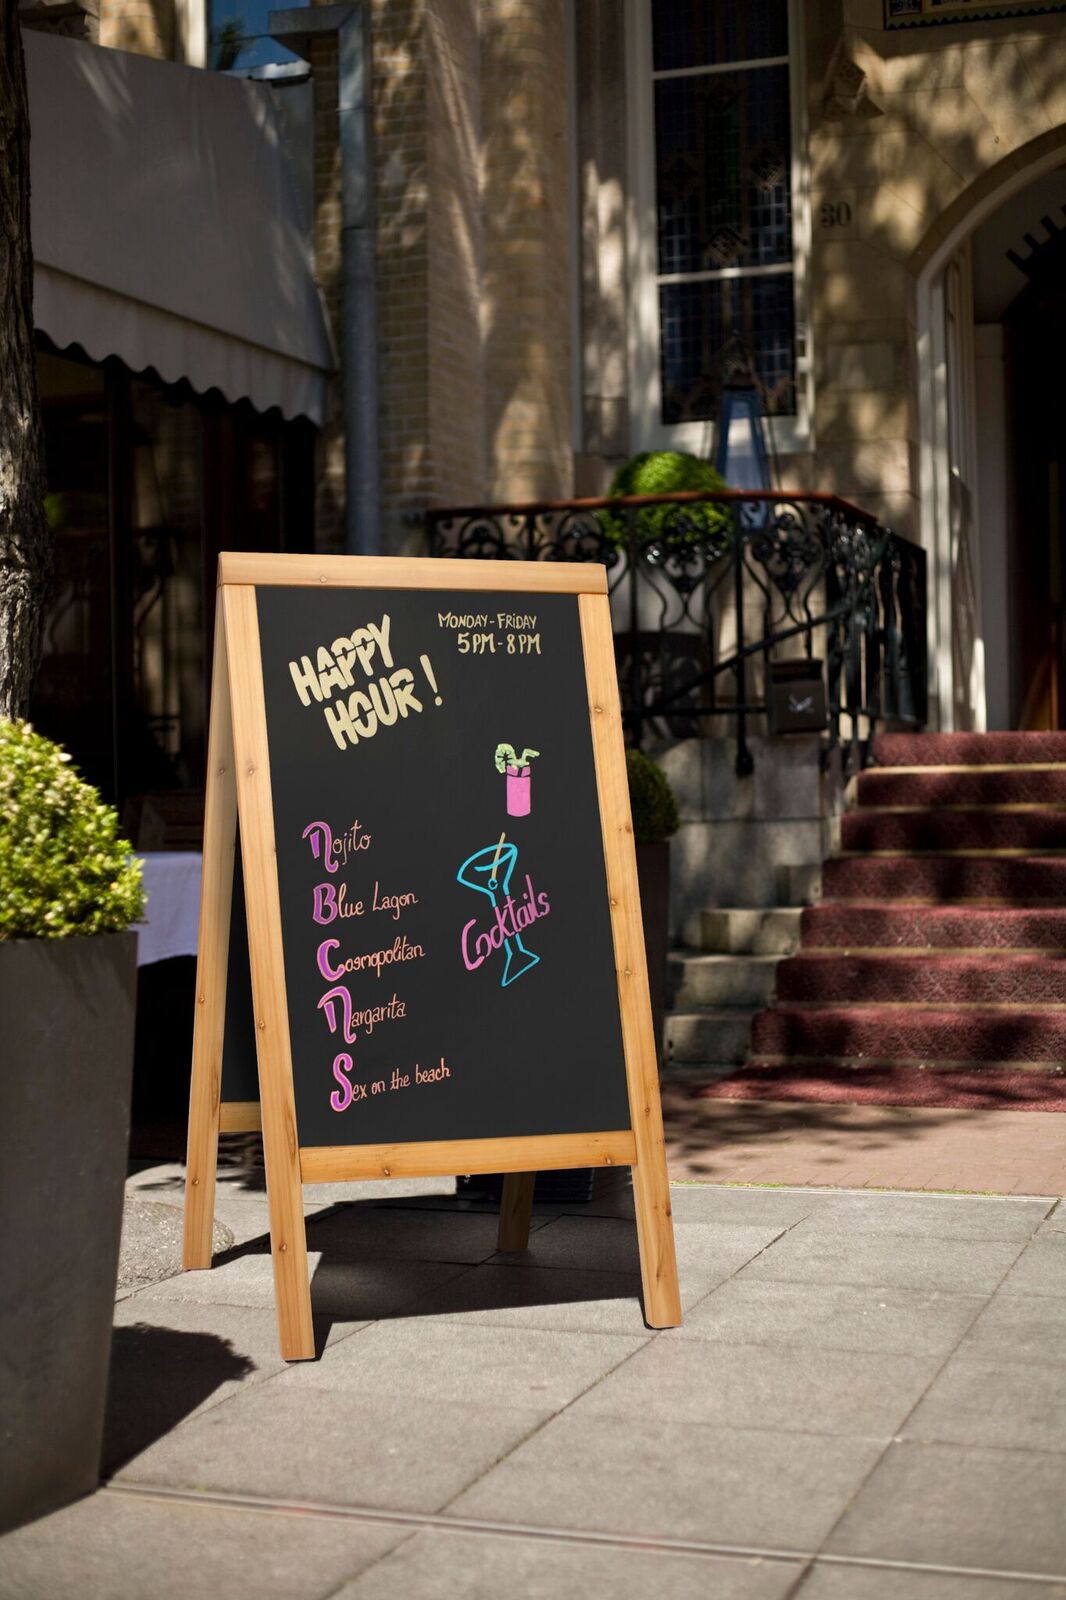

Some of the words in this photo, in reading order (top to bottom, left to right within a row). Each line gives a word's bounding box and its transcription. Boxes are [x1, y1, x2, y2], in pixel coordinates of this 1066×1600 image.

[288, 613, 394, 707] HAPPY
[312, 882, 365, 926] Blue
[372, 880, 419, 921] Lagon
[461, 874, 551, 971] Cocktails
[316, 935, 426, 983] Cosmopolitan
[329, 1052, 368, 1113] Sex
[371, 1080, 386, 1095] on
[390, 1067, 411, 1091] the
[415, 1057, 451, 1085] beach
